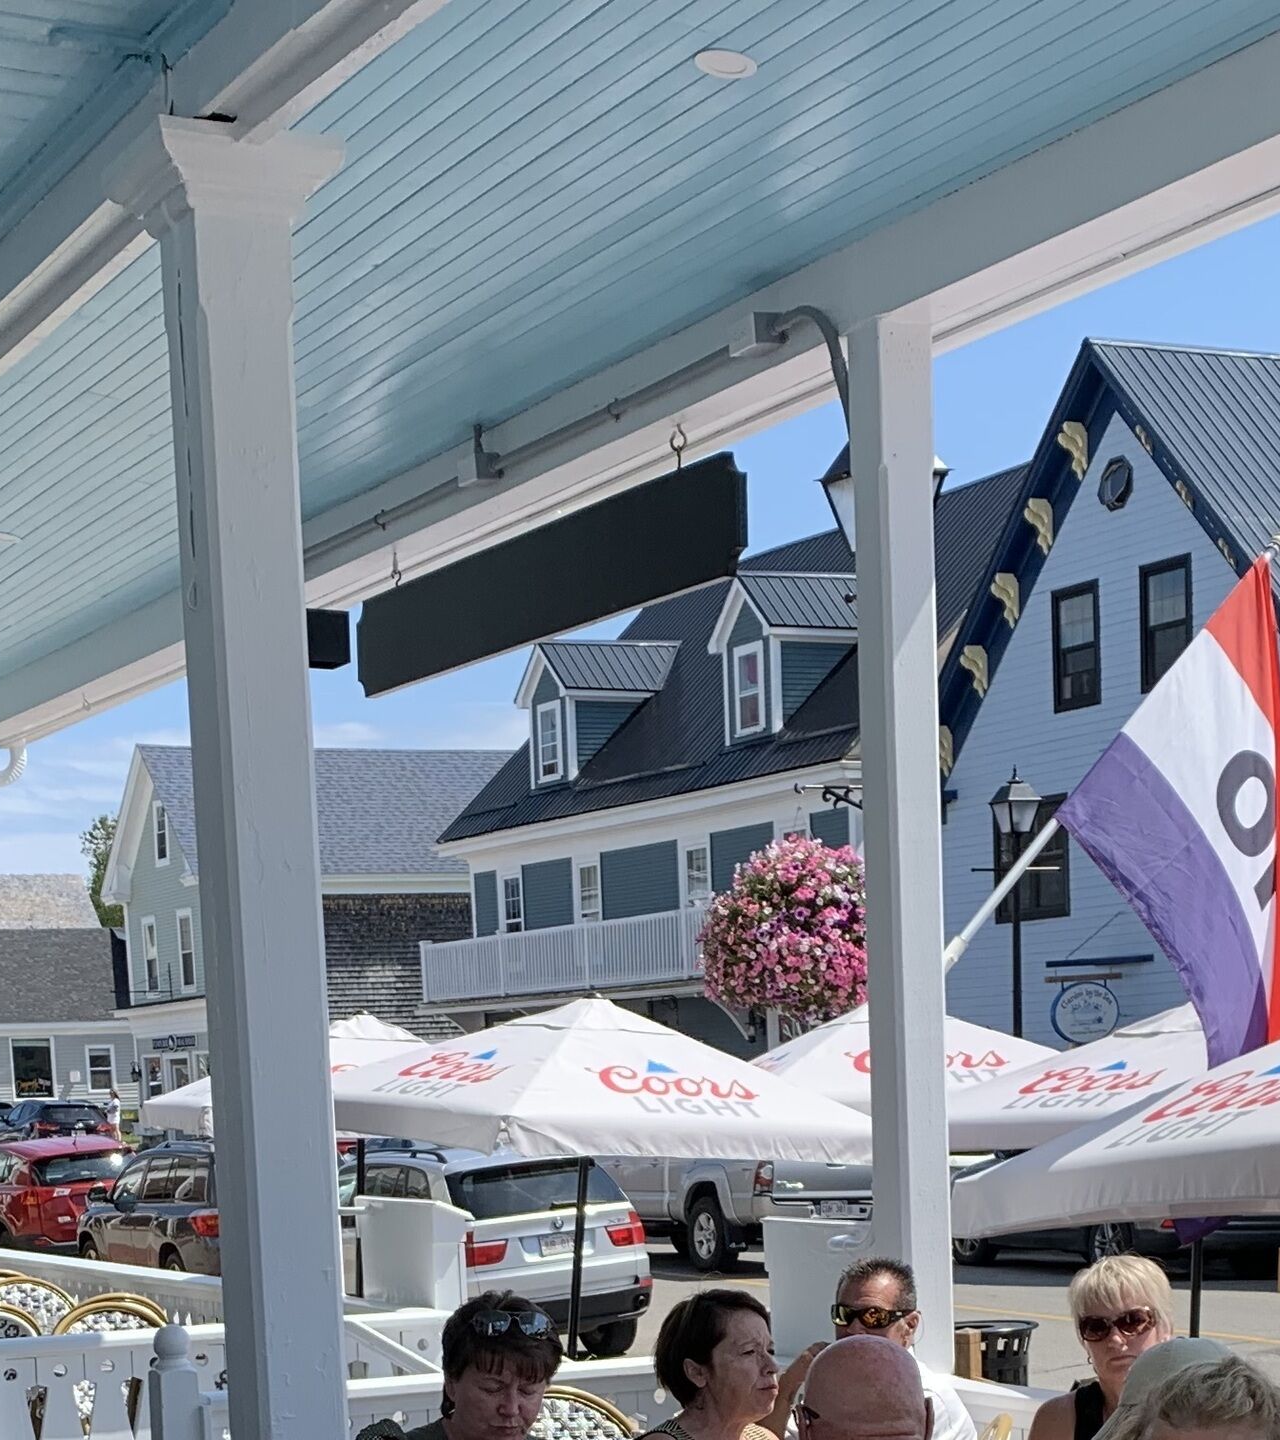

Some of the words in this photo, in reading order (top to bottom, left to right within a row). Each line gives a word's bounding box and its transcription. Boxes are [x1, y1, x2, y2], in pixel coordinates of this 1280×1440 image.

[398, 1051, 516, 1083] Coors
[1018, 1066, 1168, 1094] Coors
[372, 1078, 467, 1098] LIGHT
[584, 1065, 760, 1100] Coors
[633, 1096, 761, 1118] LIGHT
[1001, 1092, 1125, 1110] LIGHT
[1104, 1108, 1257, 1149] LIGHT
